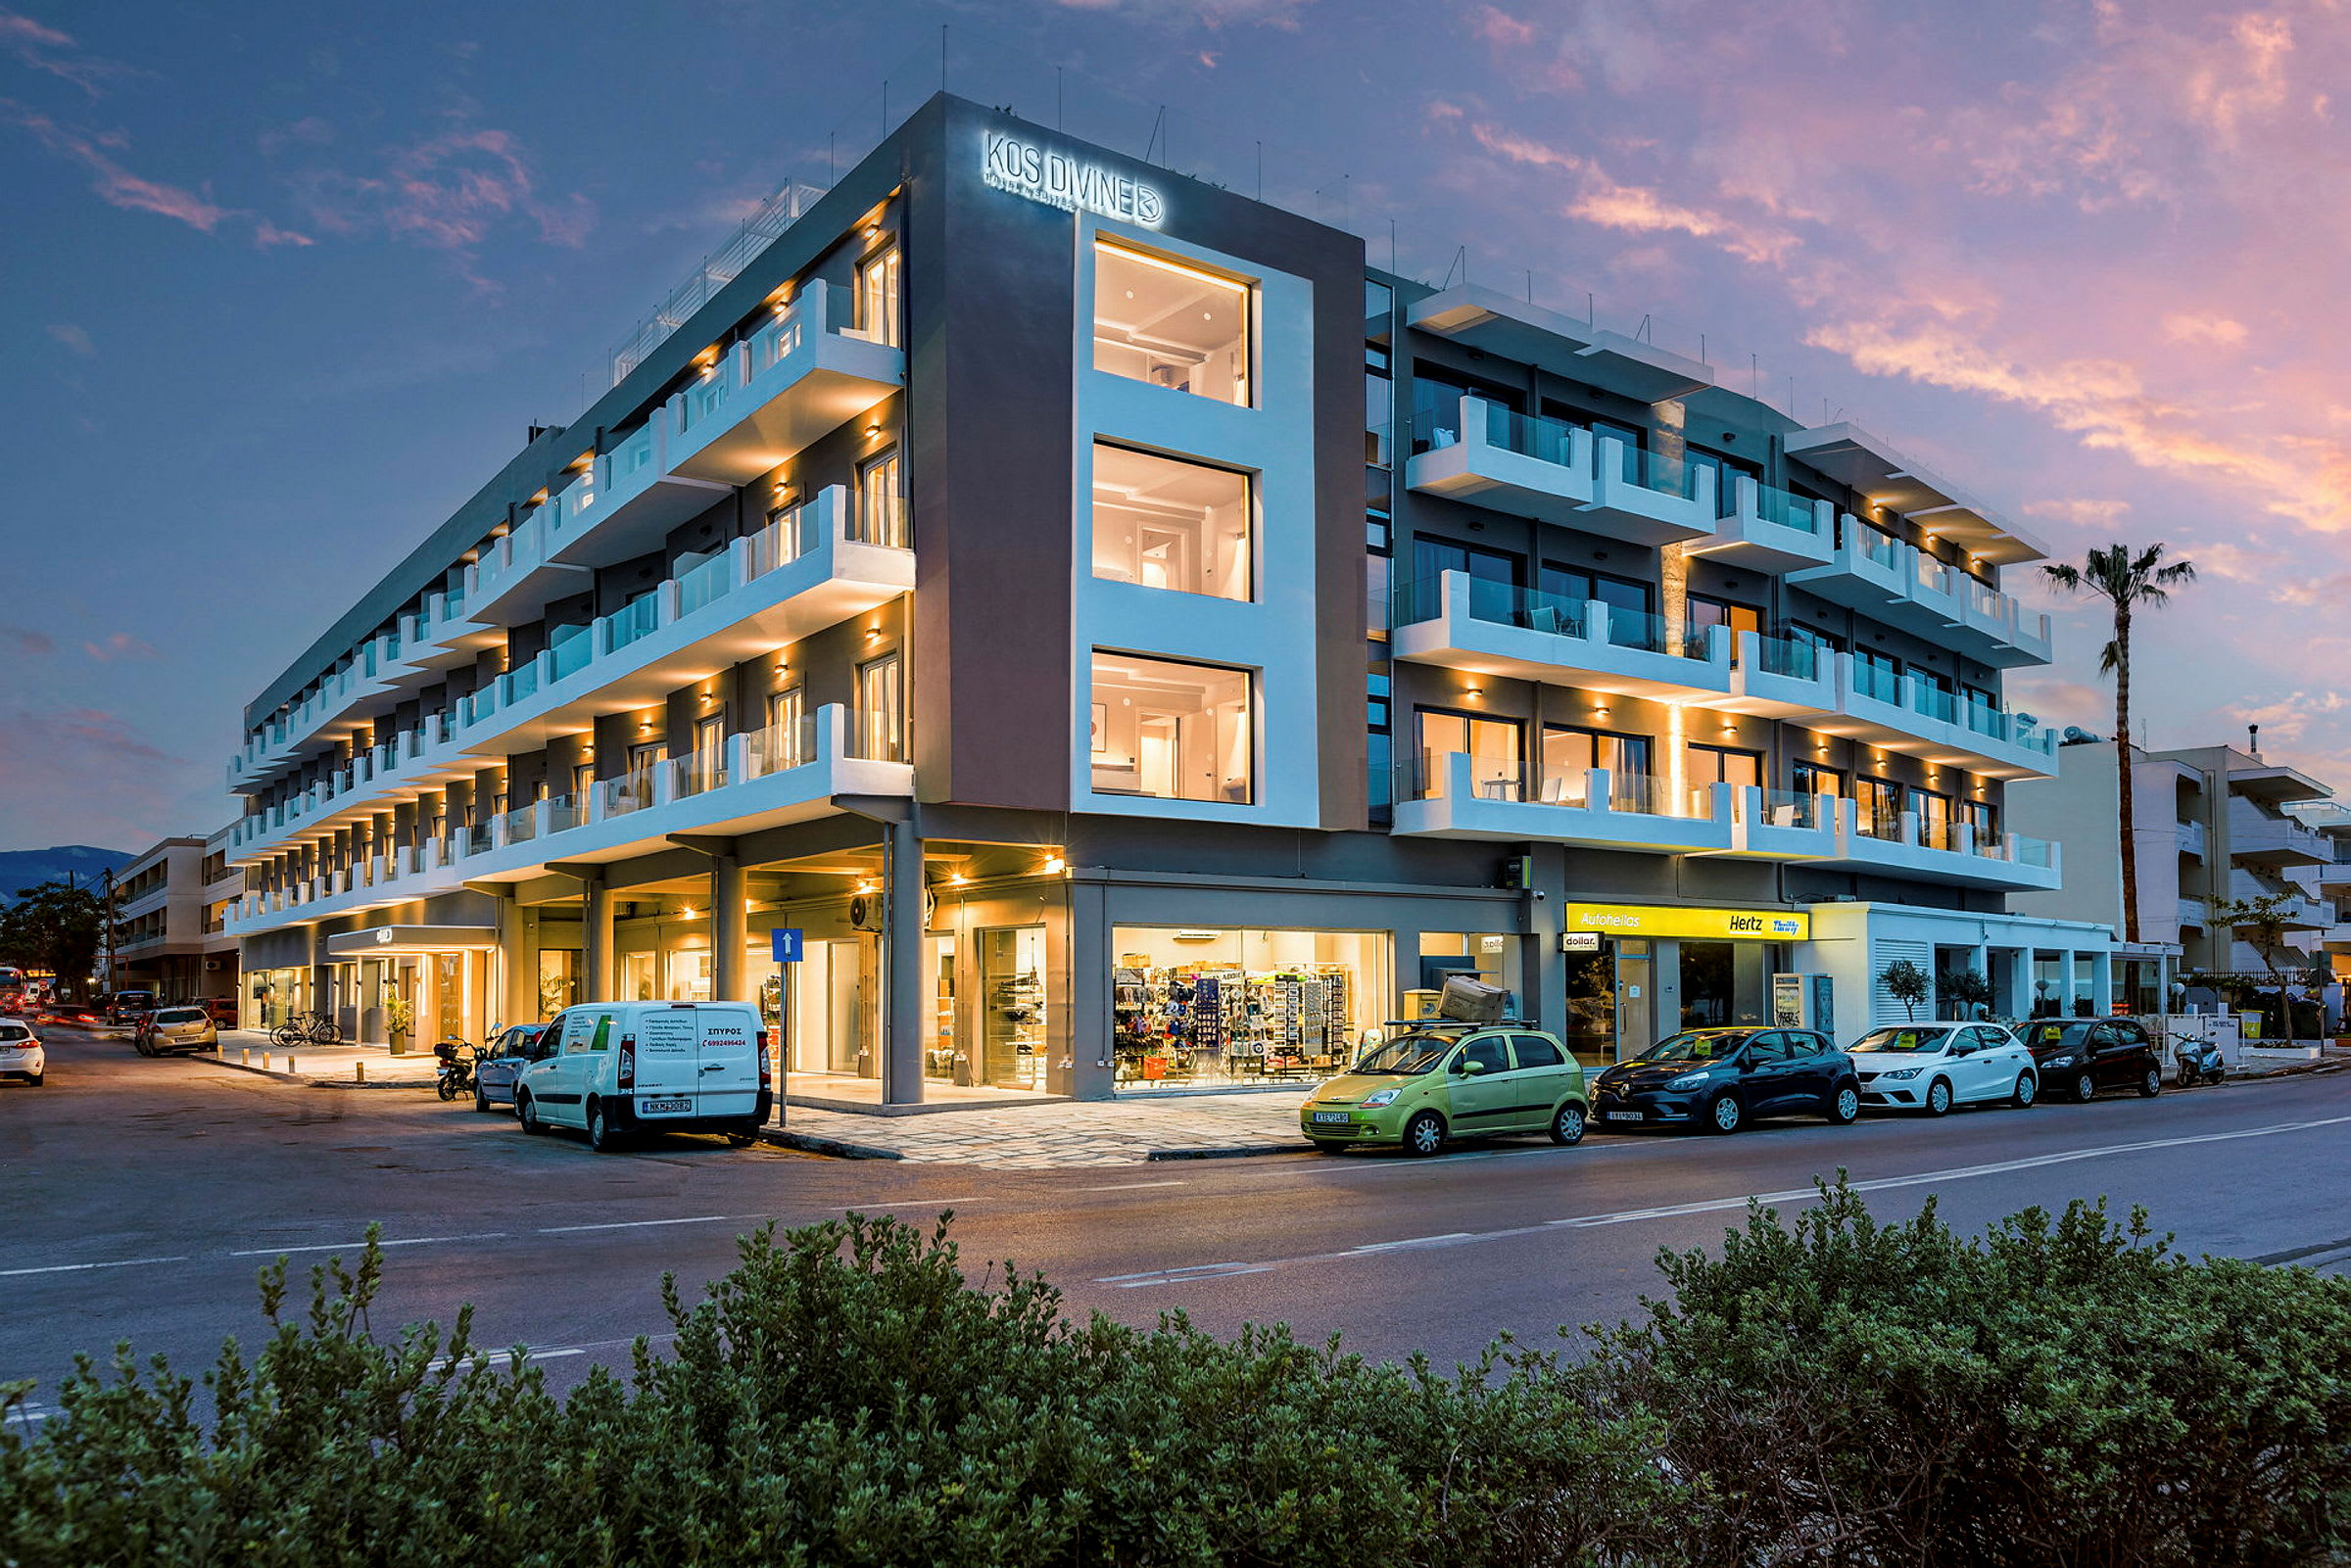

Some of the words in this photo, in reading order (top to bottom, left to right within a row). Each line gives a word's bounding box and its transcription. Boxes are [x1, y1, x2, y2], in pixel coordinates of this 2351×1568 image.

[986, 133, 1040, 184] KOS
[1050, 156, 1132, 215] DIVINE
[1730, 916, 1763, 930] Hertz
